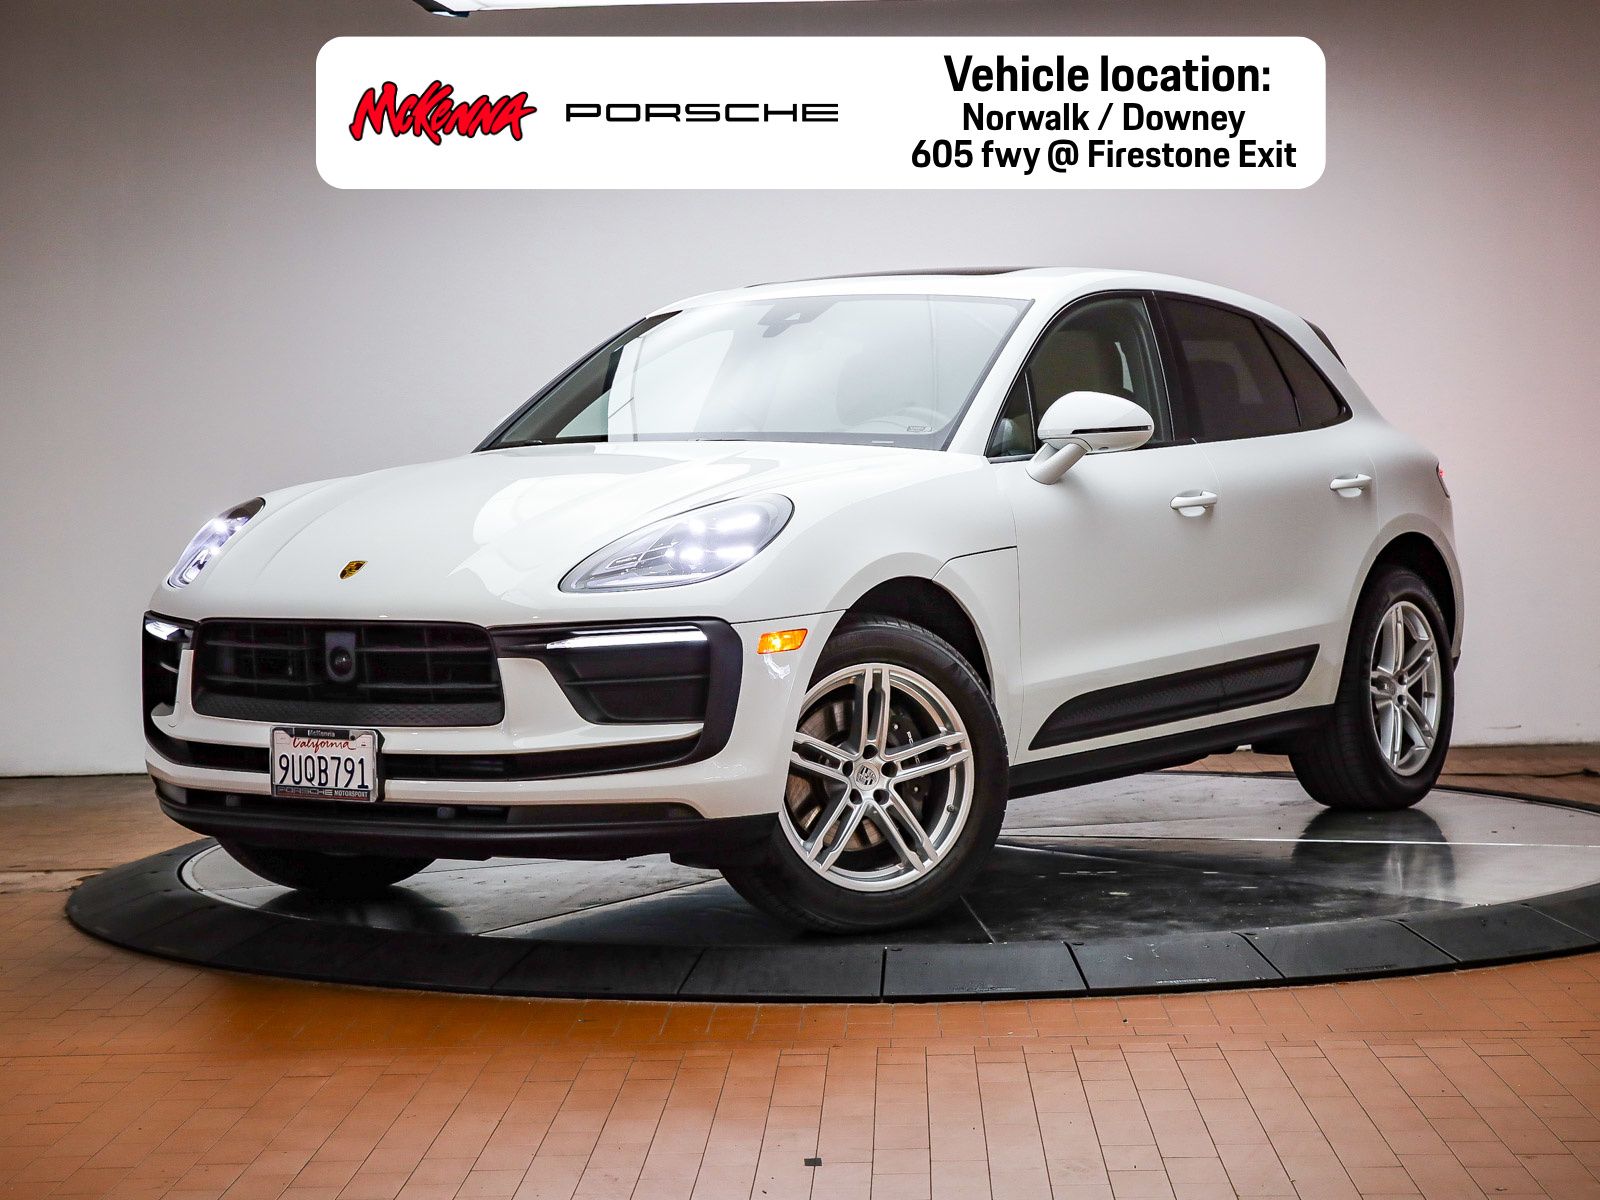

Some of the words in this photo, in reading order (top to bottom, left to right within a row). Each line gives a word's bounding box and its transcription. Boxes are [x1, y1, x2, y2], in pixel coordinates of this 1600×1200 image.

[292, 738, 357, 754] California
[279, 754, 370, 789] 9UQB791
[334, 789, 369, 798] MOTORSPORT
